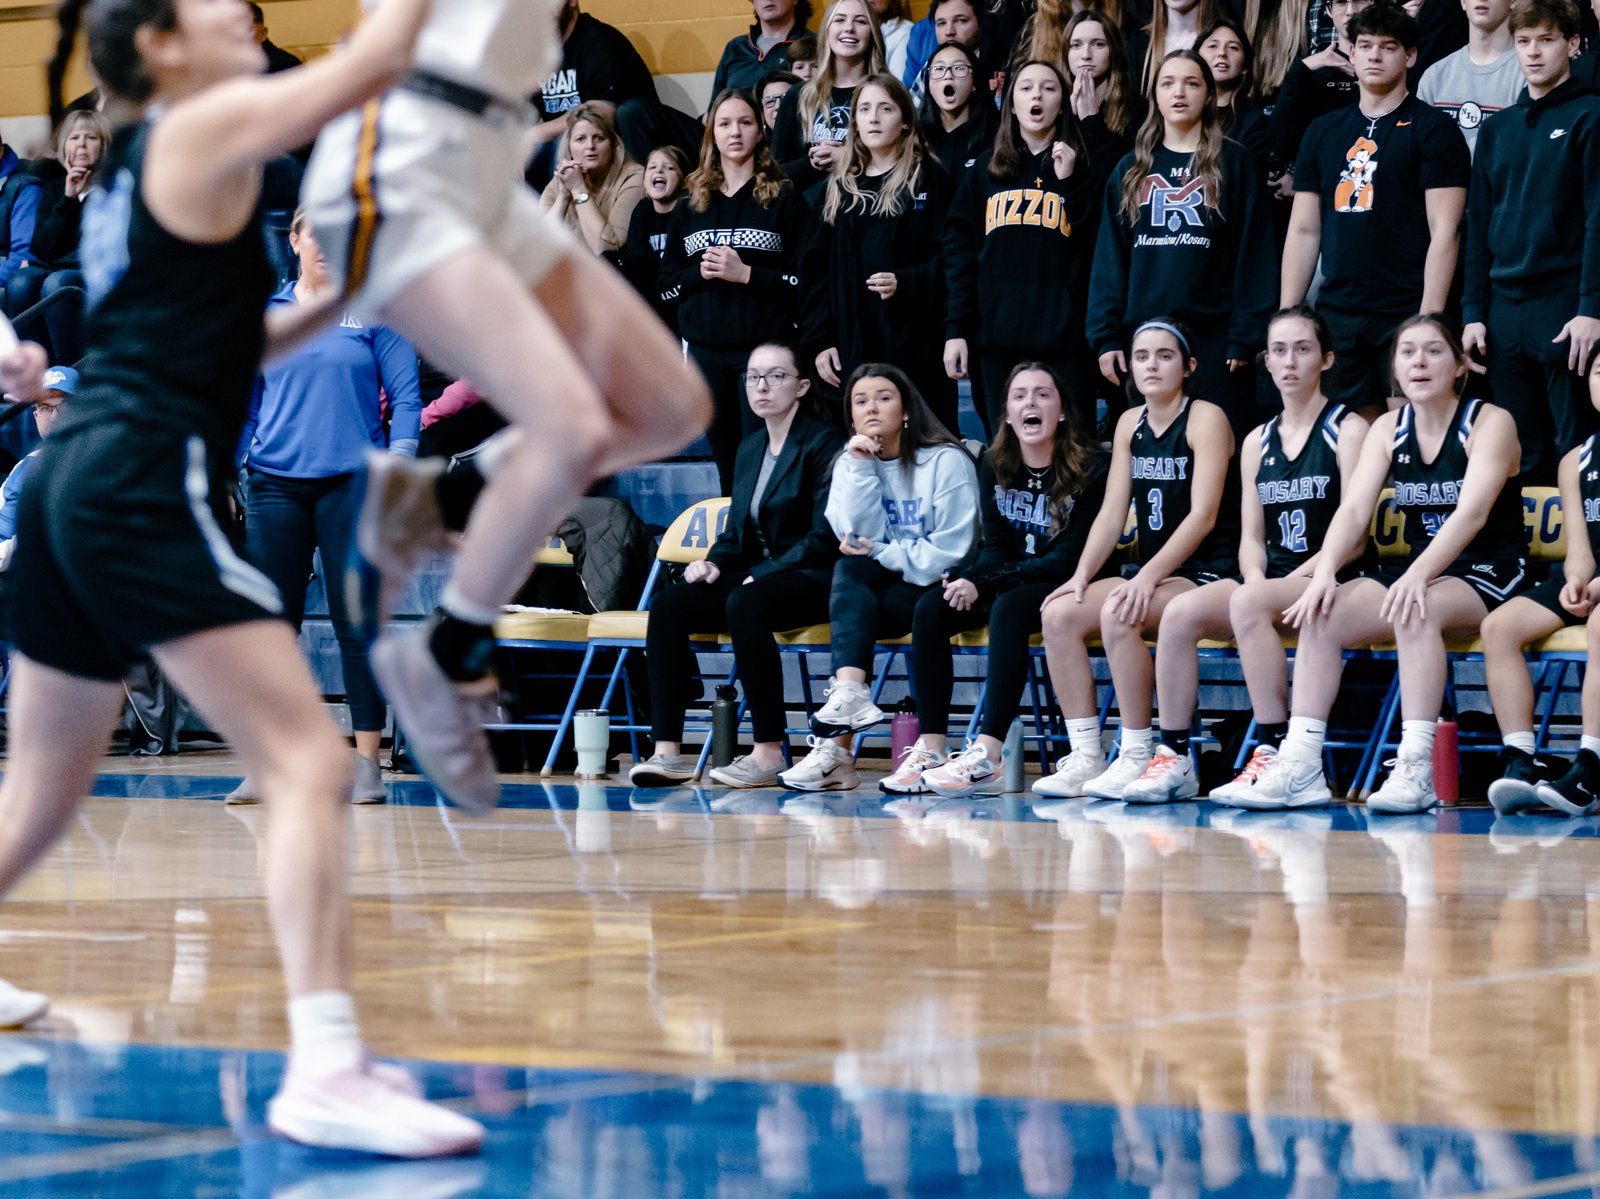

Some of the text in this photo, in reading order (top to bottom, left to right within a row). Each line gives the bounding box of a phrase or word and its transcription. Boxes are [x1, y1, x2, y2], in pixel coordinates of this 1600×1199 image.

[1461, 108, 1479, 123] NIU
[994, 485, 1075, 527] ROSA
[1147, 488, 1163, 531] 3
[1257, 476, 1330, 505] ROSARY
[1278, 509, 1308, 552] 12
